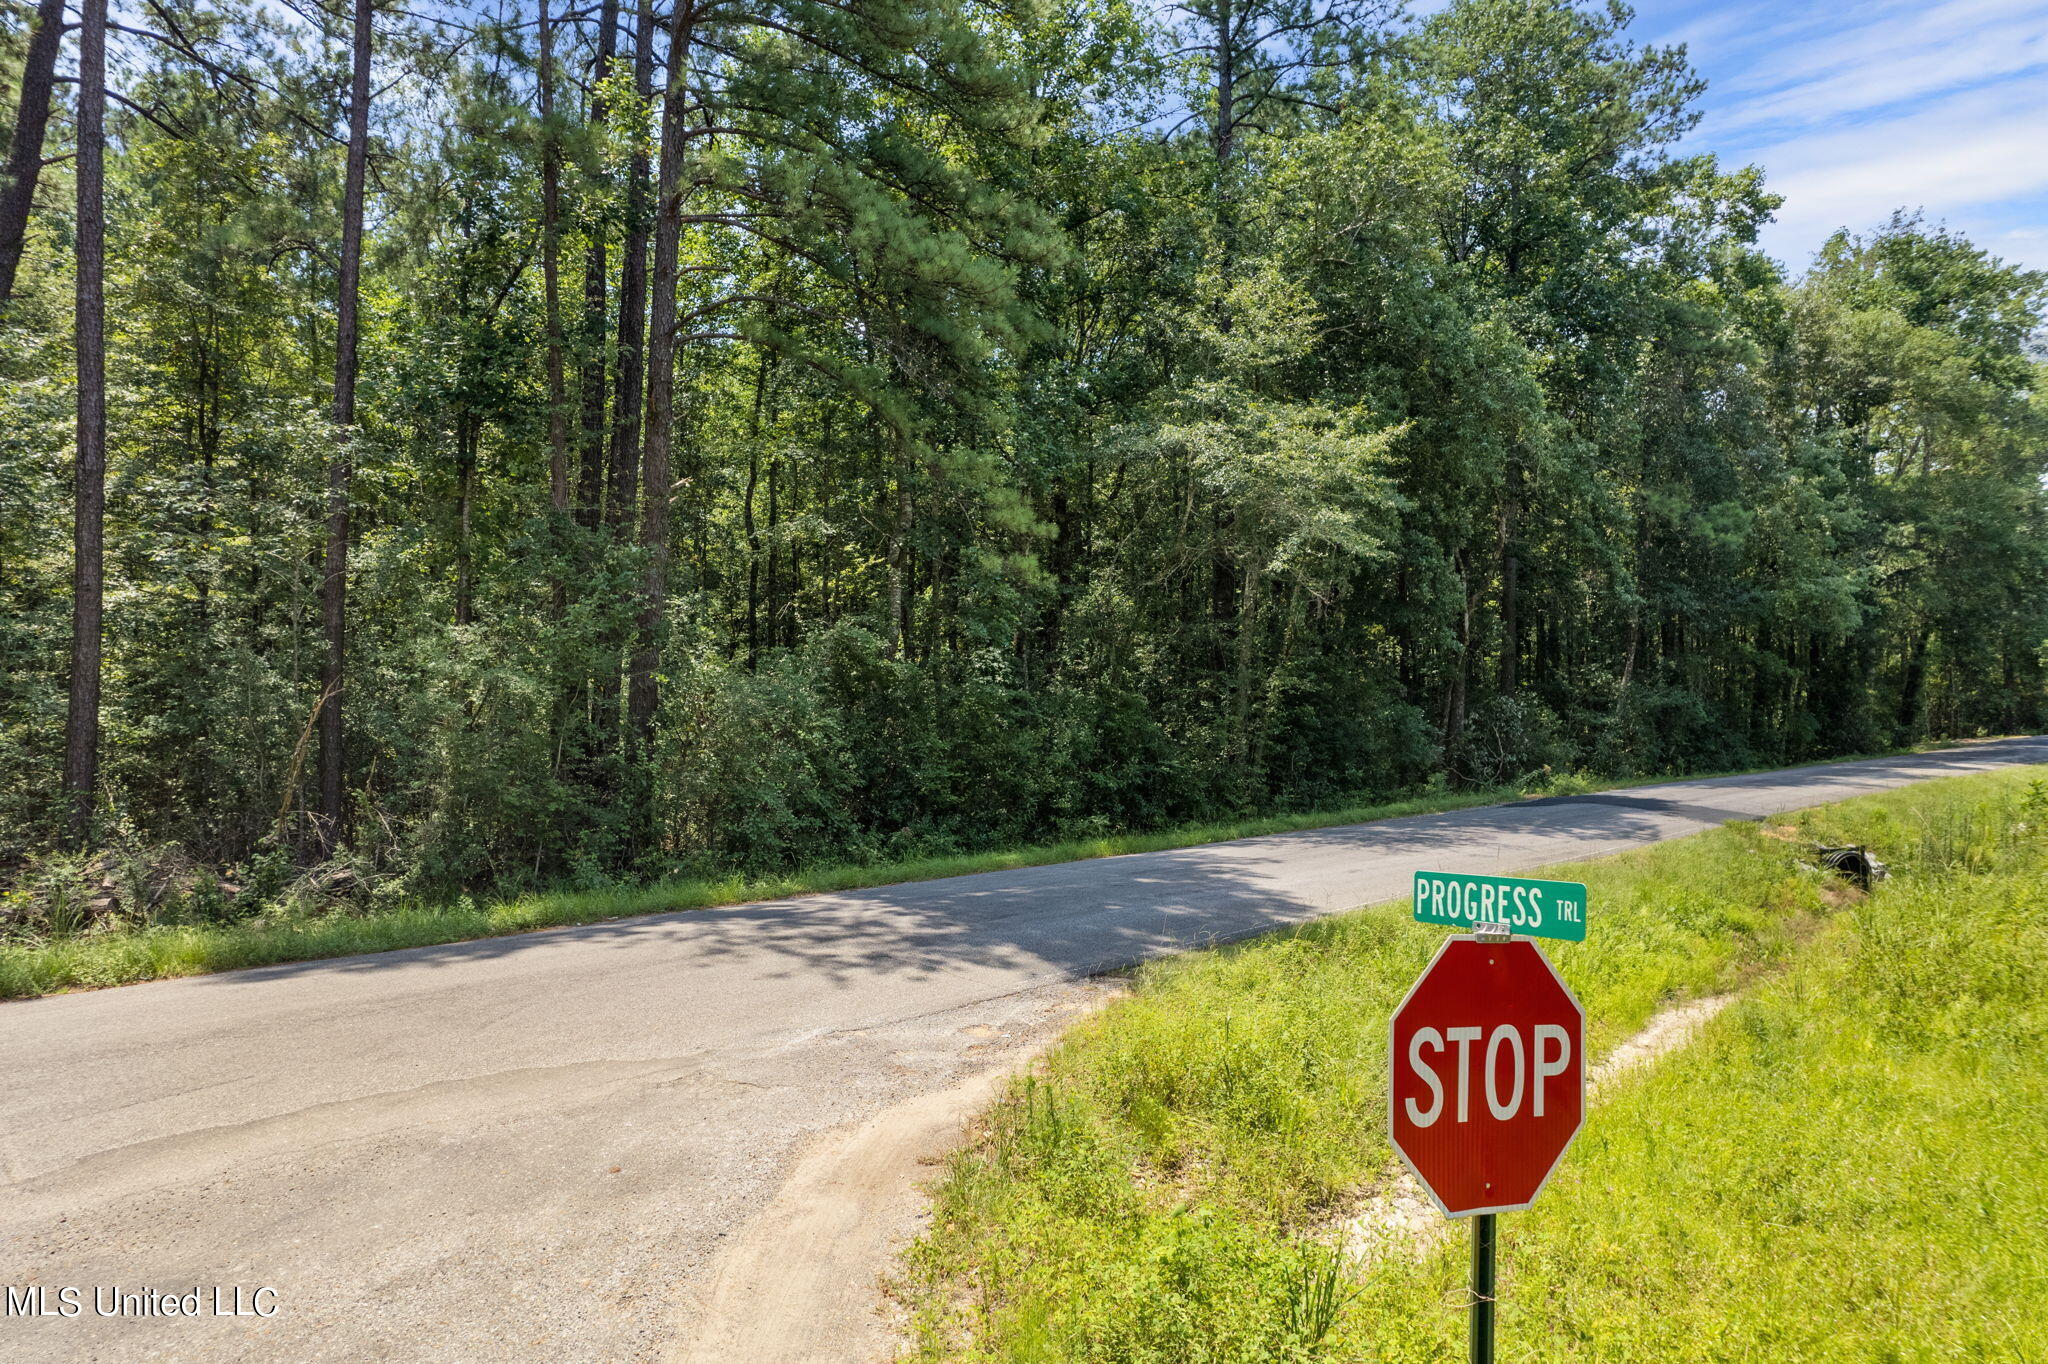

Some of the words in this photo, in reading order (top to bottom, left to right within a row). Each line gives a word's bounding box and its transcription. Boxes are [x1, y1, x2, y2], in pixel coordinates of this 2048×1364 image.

[1417, 878, 1543, 928] PROGRESS
[1556, 899, 1582, 923] TRL
[1405, 1024, 1571, 1128] STOP
